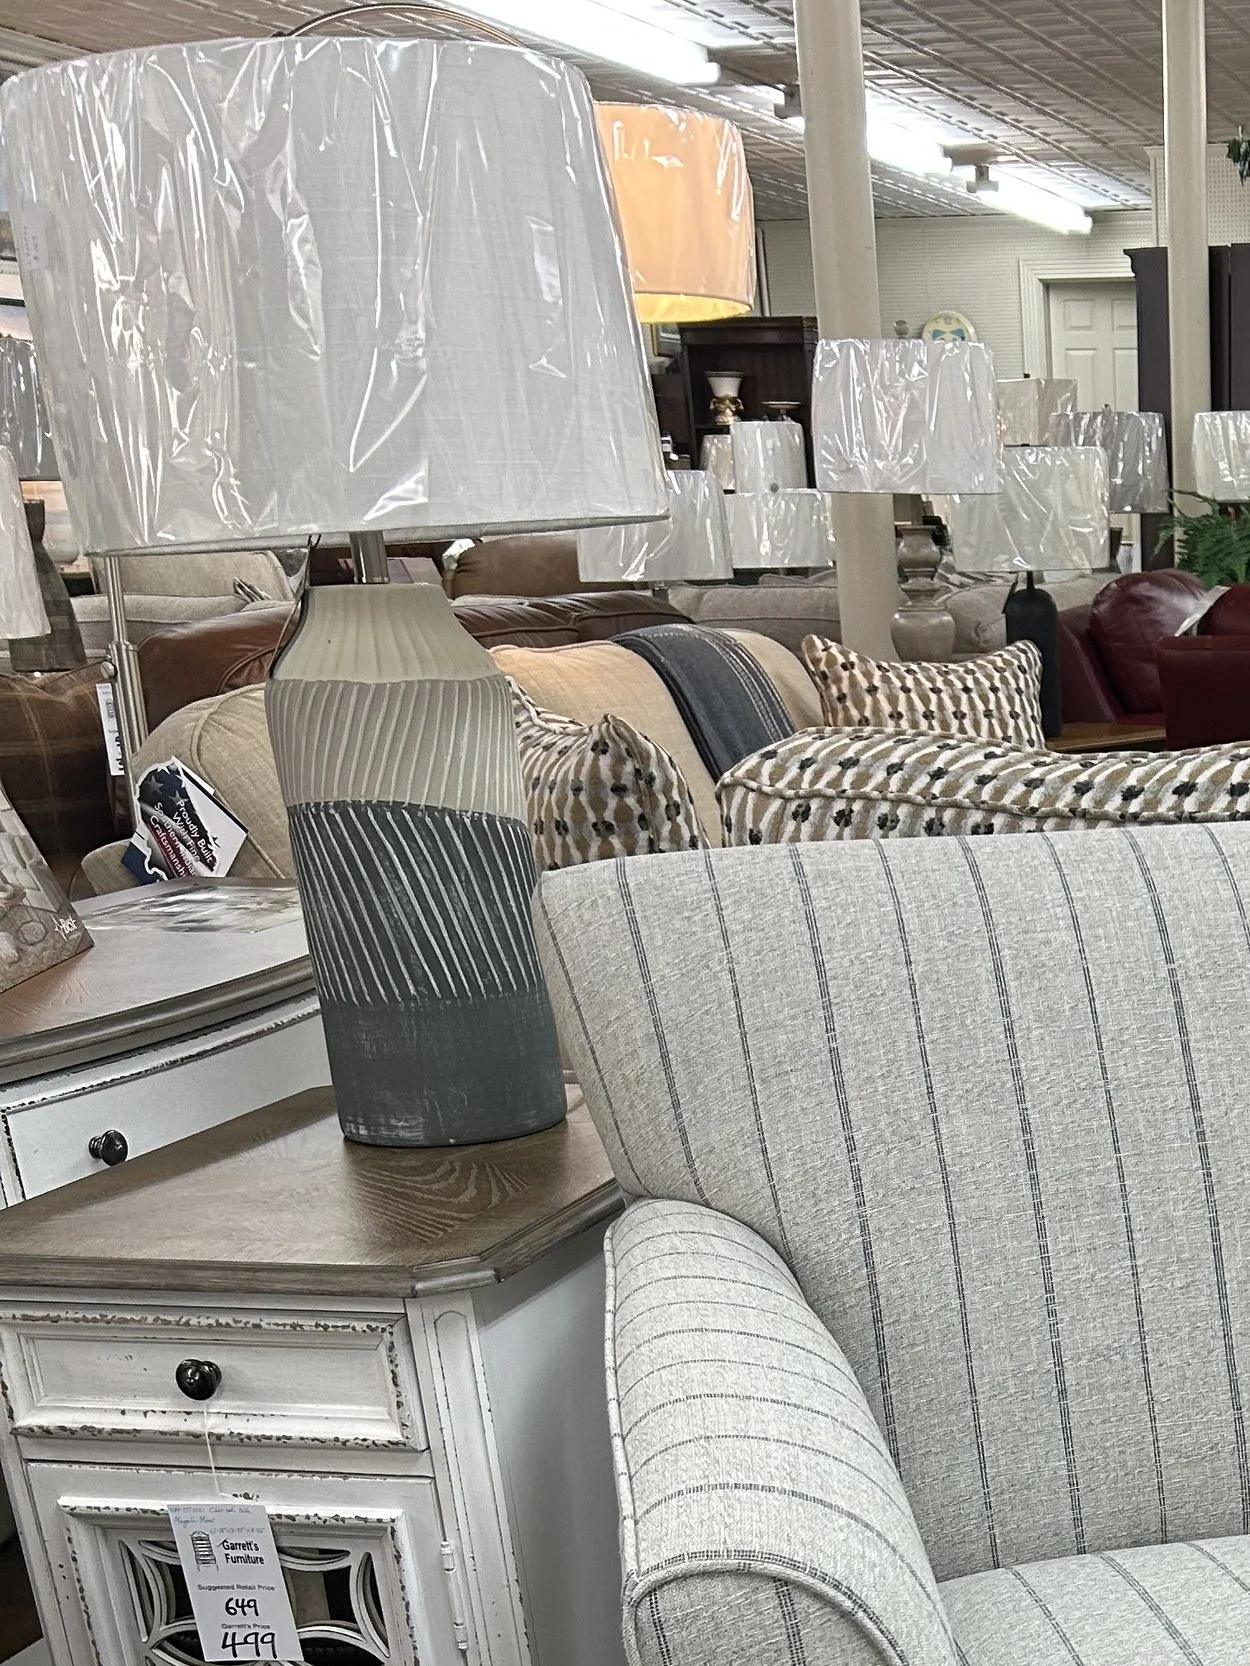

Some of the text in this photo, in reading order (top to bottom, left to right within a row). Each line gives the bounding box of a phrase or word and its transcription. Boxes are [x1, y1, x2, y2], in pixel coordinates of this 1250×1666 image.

[173, 811, 201, 863] With Fine
[176, 799, 213, 864] Proudly Built
[150, 815, 187, 878] Craftsmanshi
[221, 1539, 260, 1552] Garrett's
[224, 1553, 265, 1566] Furniture
[197, 1584, 235, 1592] Suggested
[257, 1584, 276, 1592] Price
[224, 1597, 260, 1617] 649
[221, 1631, 278, 1660] 499
